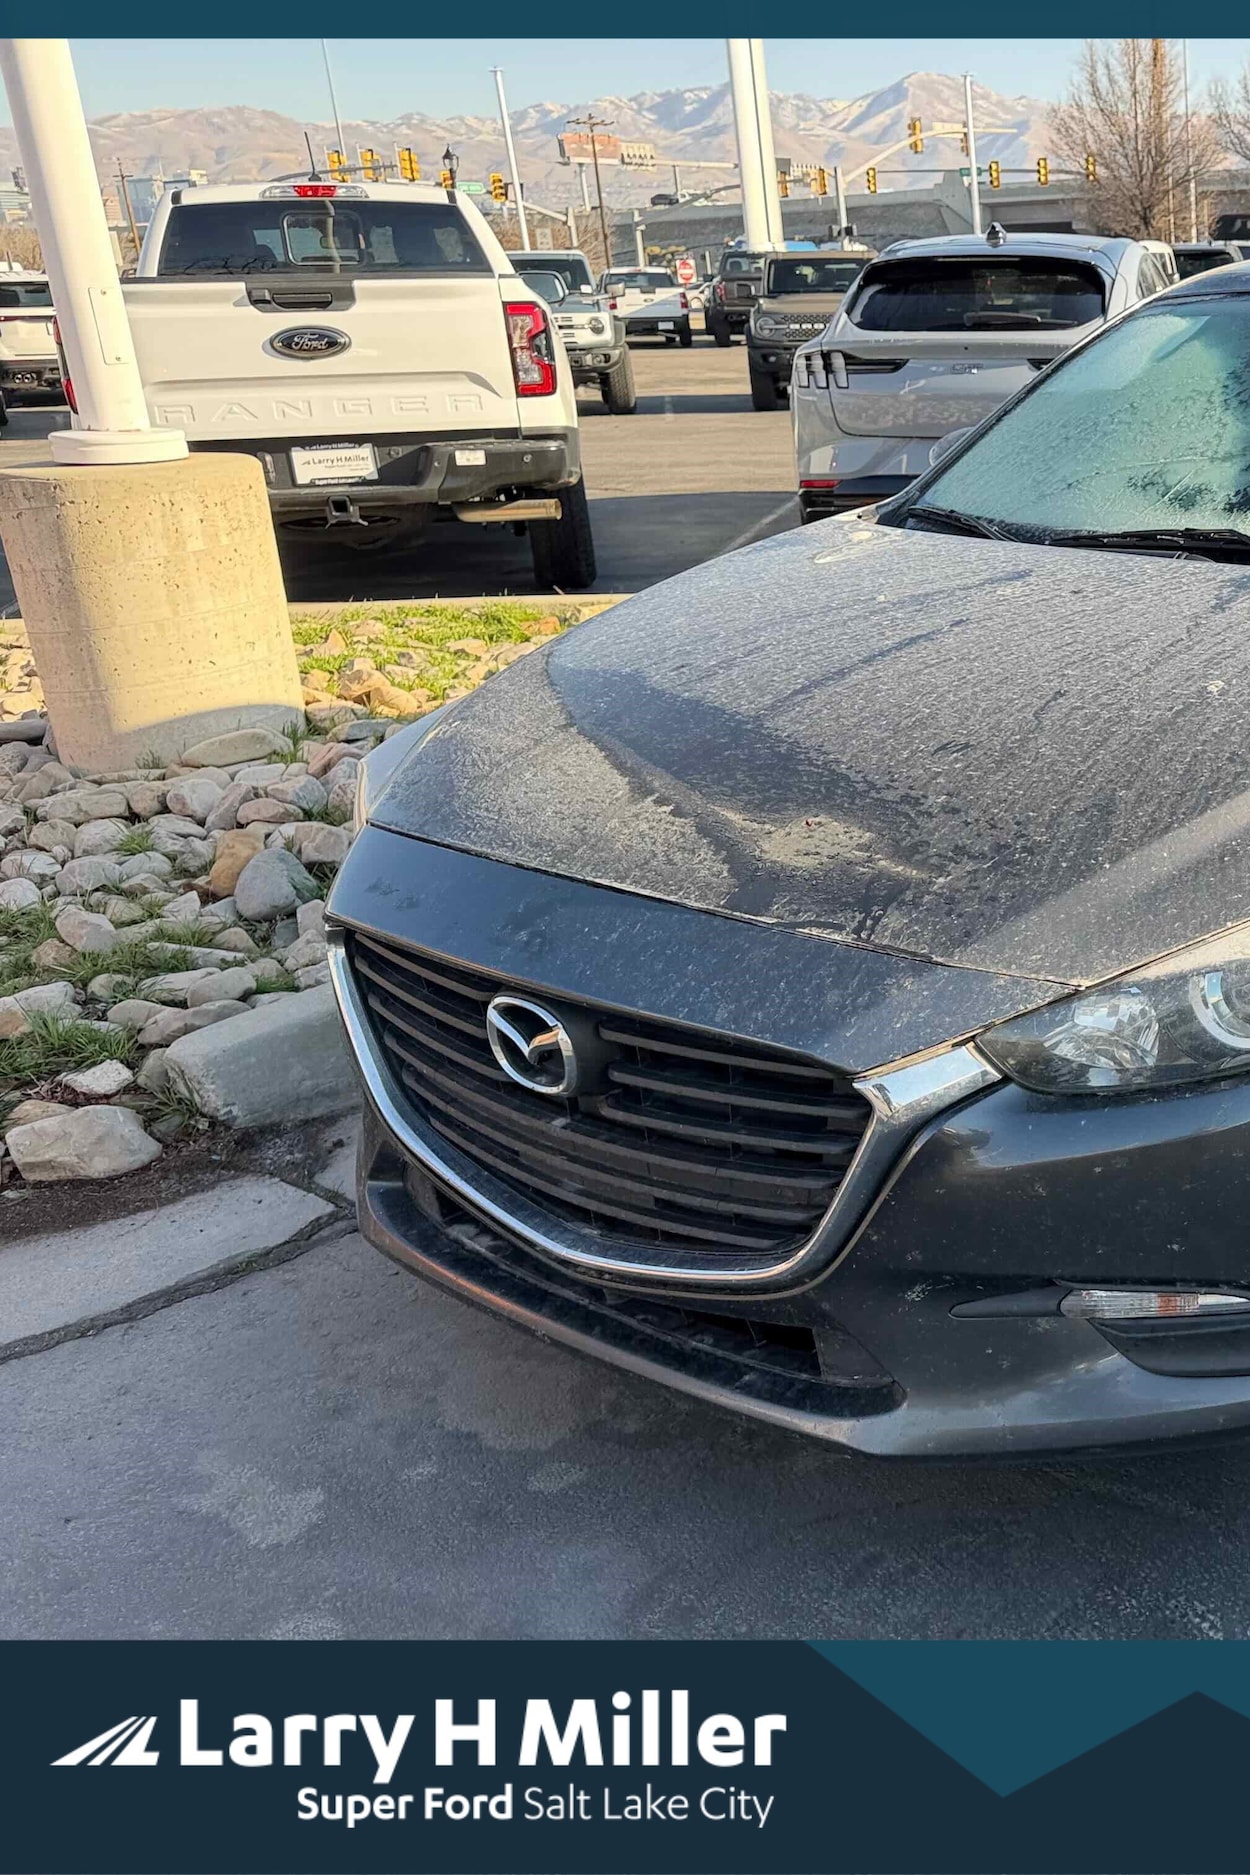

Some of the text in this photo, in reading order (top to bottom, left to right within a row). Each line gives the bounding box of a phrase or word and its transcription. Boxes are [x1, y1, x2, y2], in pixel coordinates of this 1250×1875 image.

[292, 332, 328, 352] Ford
[154, 393, 483, 424] RANGER
[312, 457, 335, 465] Larry
[344, 454, 369, 462] Miller
